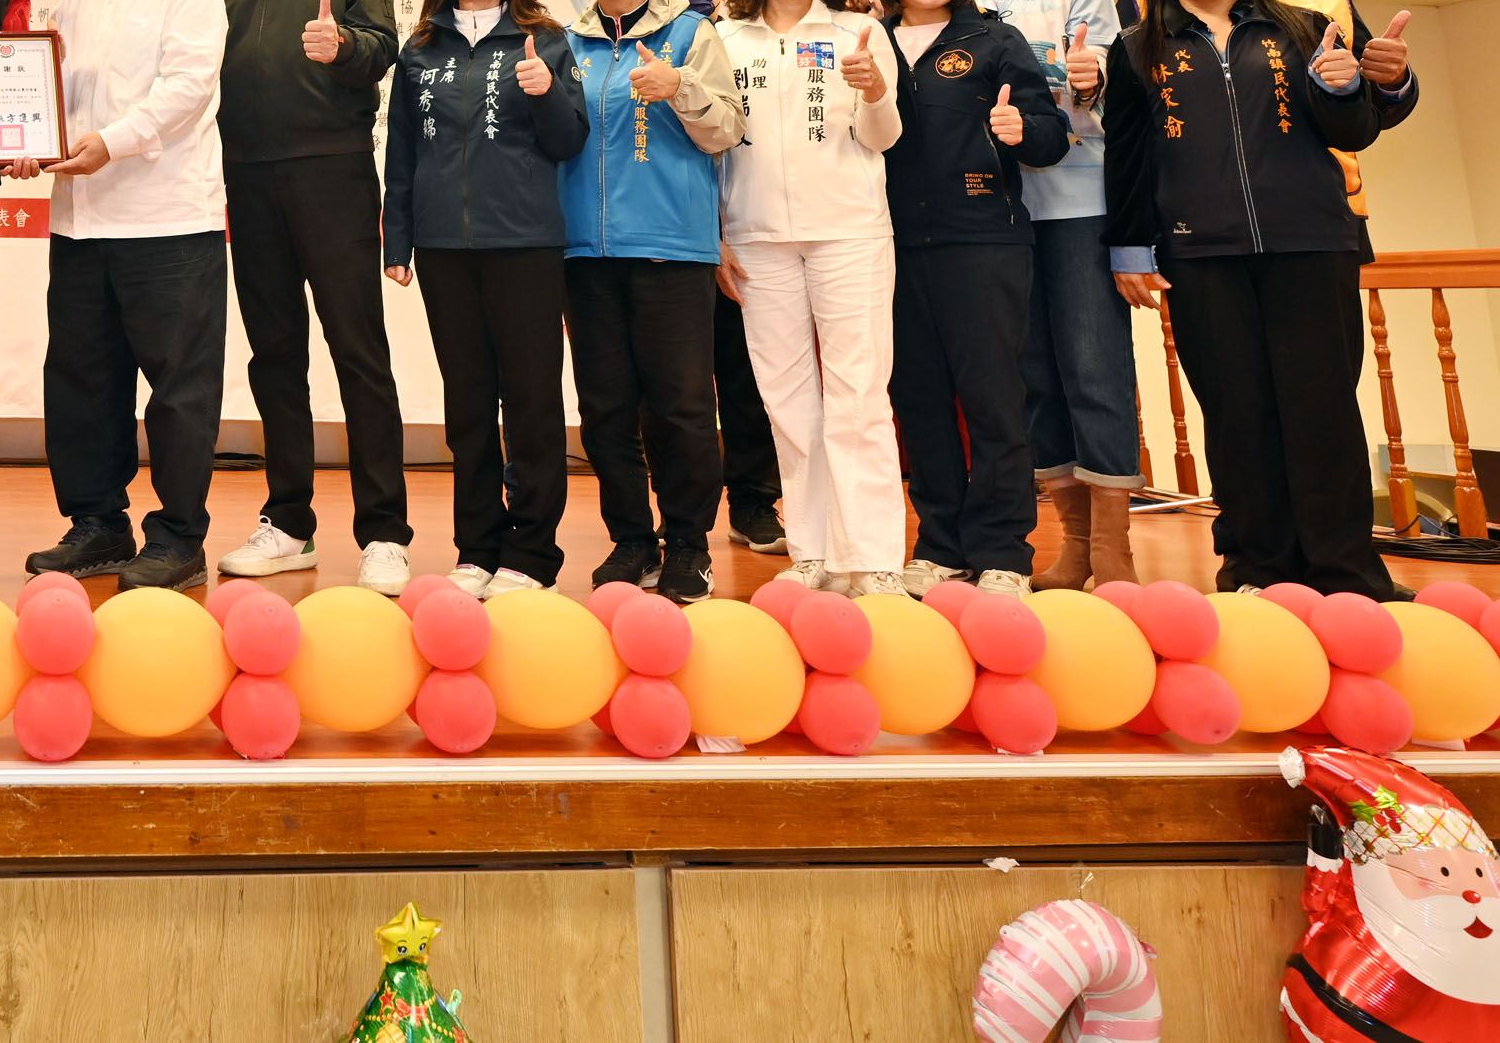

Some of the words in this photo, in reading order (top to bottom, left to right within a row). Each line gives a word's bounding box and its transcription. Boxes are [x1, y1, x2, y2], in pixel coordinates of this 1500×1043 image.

[440, 58, 457, 83] 主席
[751, 58, 768, 89] 助理
[1174, 49, 1194, 73] 代表
[1261, 38, 1292, 134] 竹南鎮民代表會
[419, 68, 440, 141] 何秀綿
[484, 50, 505, 140] 竹南鎮民代表會
